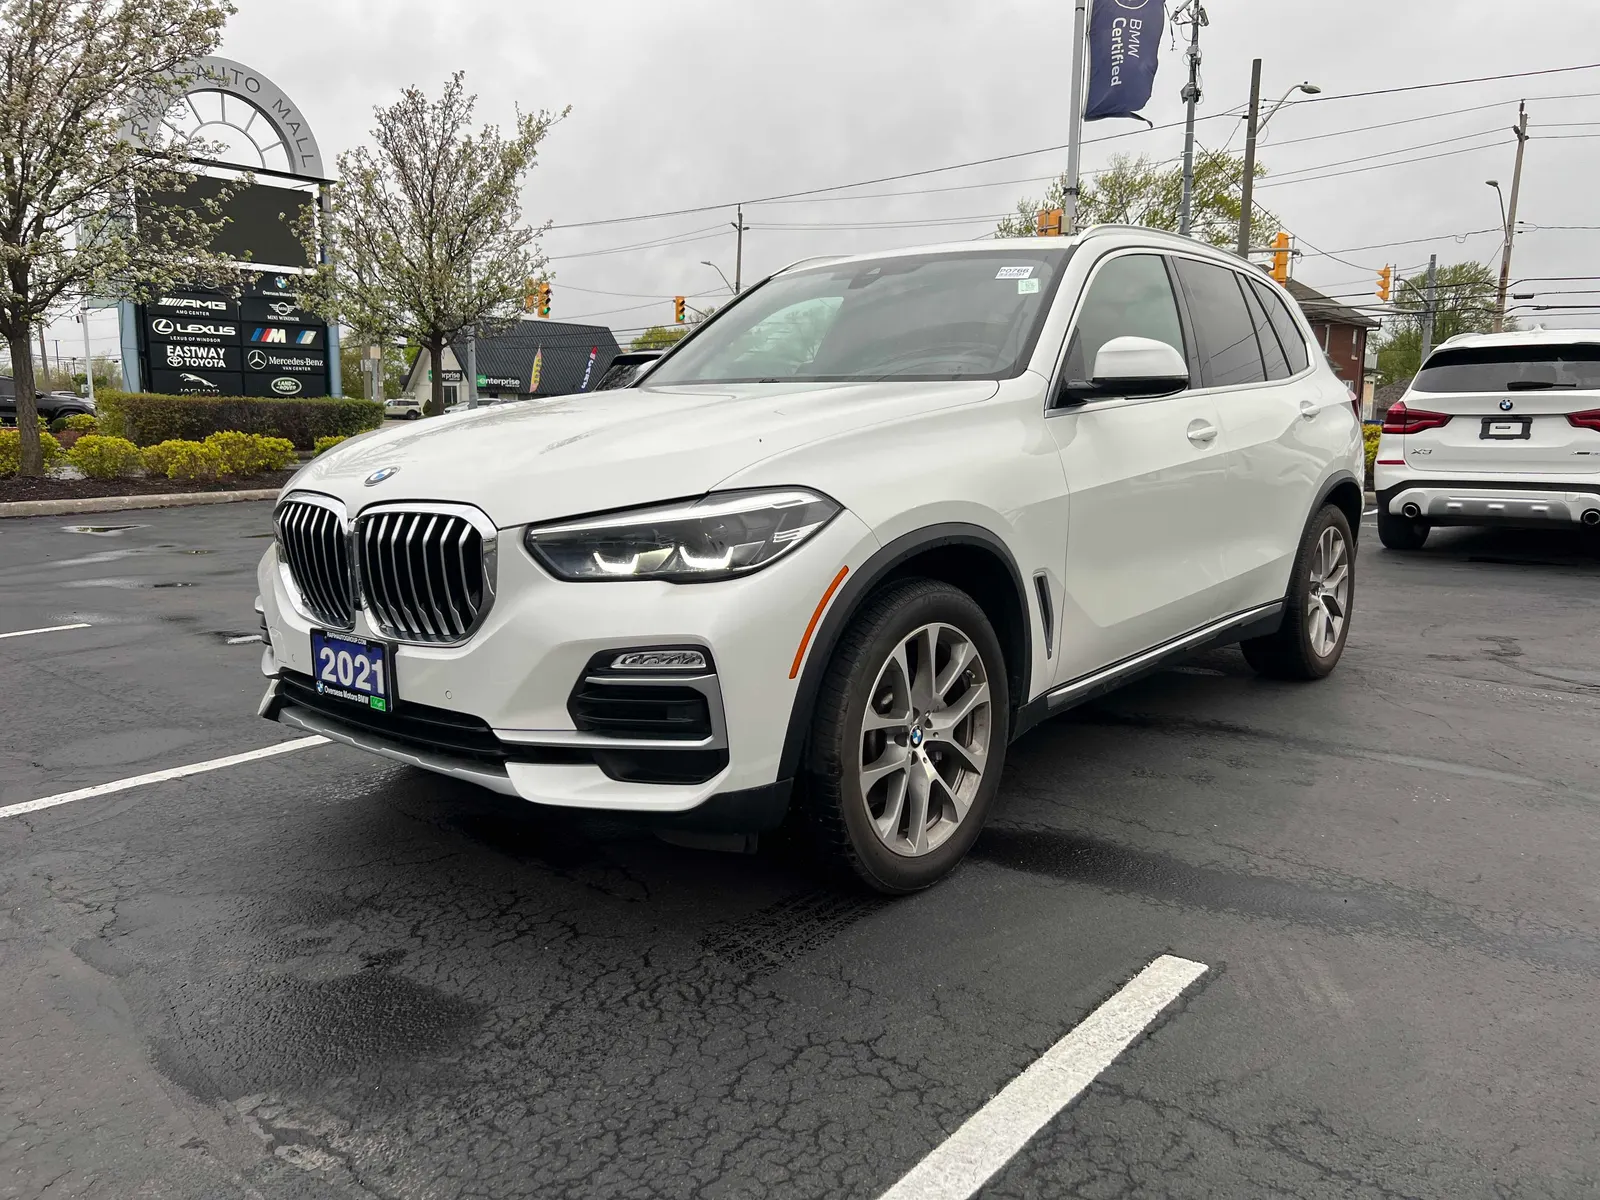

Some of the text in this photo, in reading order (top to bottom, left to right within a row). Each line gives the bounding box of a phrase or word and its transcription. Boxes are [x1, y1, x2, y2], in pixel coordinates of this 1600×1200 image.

[1128, 18, 1142, 58] BMW
[1111, 17, 1127, 87] Certified
[272, 98, 314, 168] MALL
[180, 298, 227, 310] AMG
[176, 323, 236, 335] LEXUS
[166, 345, 226, 359] EASTWAY
[184, 358, 227, 368] TOYOTA
[269, 356, 323, 366] Mercedes-Benz
[479, 377, 520, 387] enterprise
[320, 646, 384, 695] 2021
[324, 685, 343, 698] Overseas
[343, 690, 358, 702] Motors
[357, 694, 369, 705] BMW
